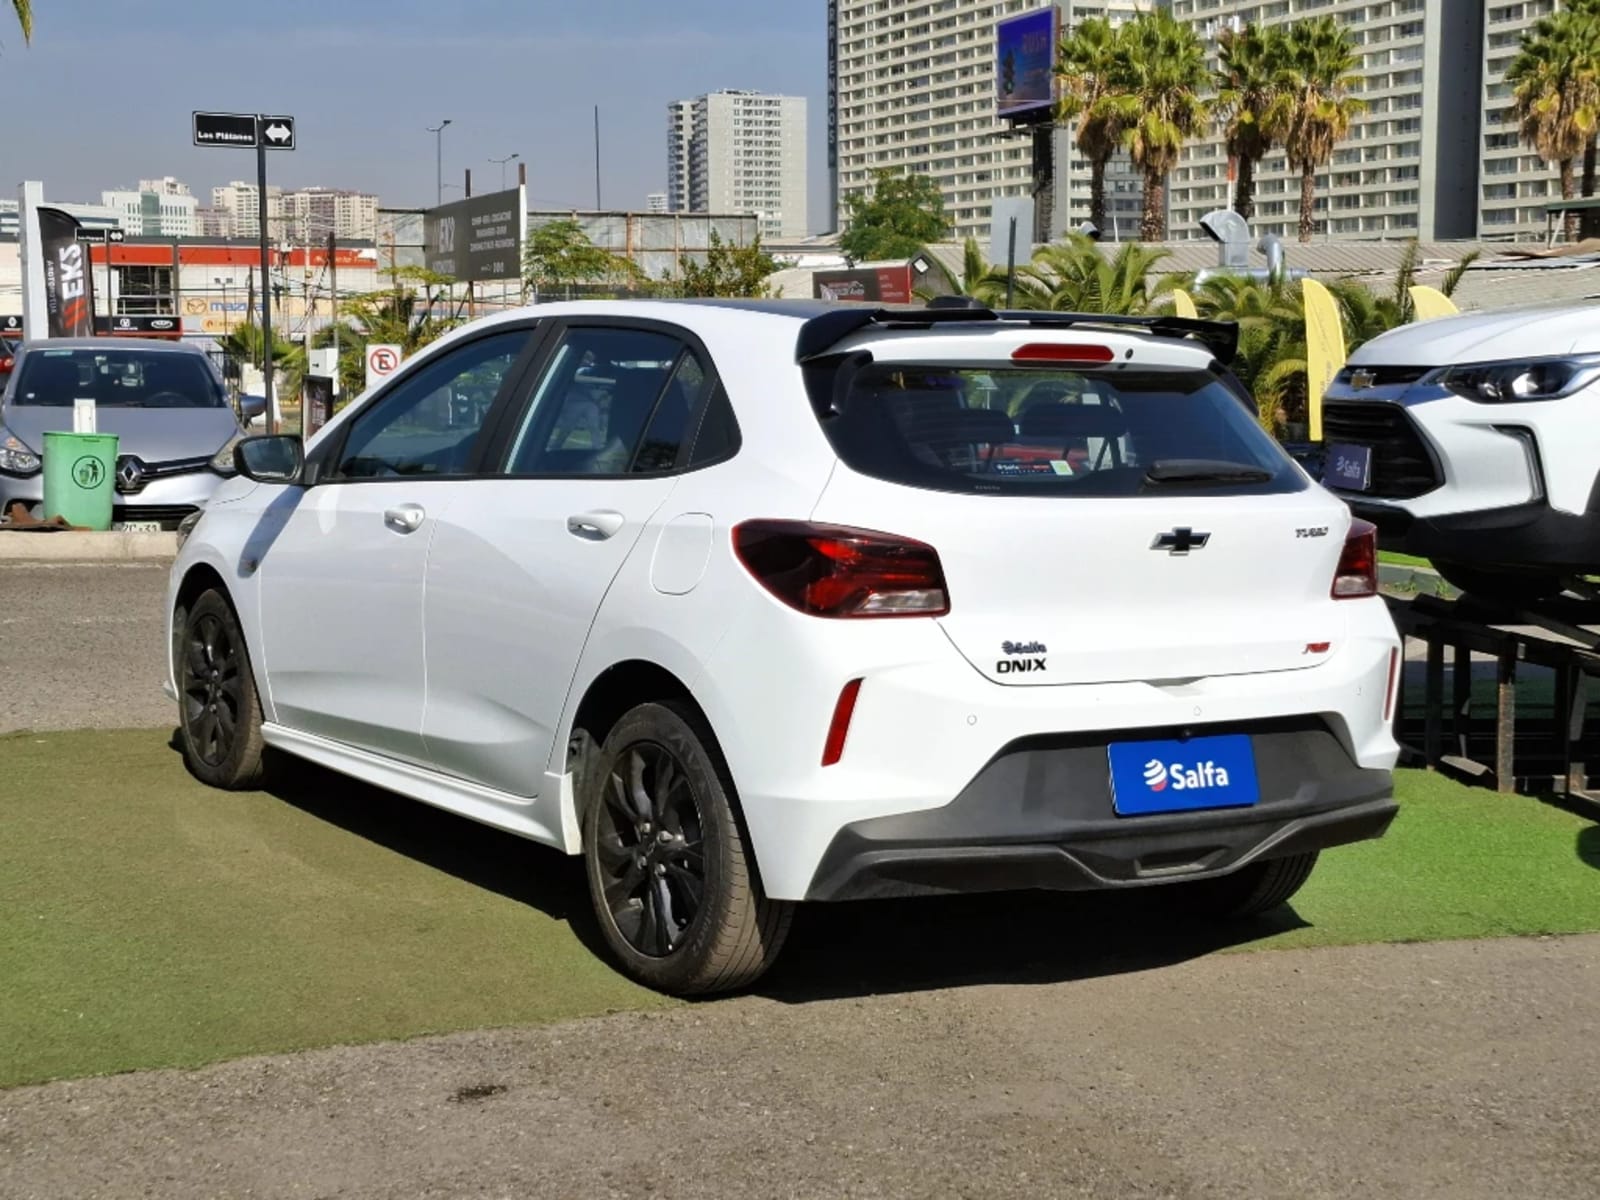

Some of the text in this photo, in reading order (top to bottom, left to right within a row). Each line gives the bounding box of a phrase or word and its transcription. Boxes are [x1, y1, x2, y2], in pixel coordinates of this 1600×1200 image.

[210, 302, 266, 312] maza
[996, 657, 1047, 674] ONIX
[1169, 760, 1230, 790] Salfa
